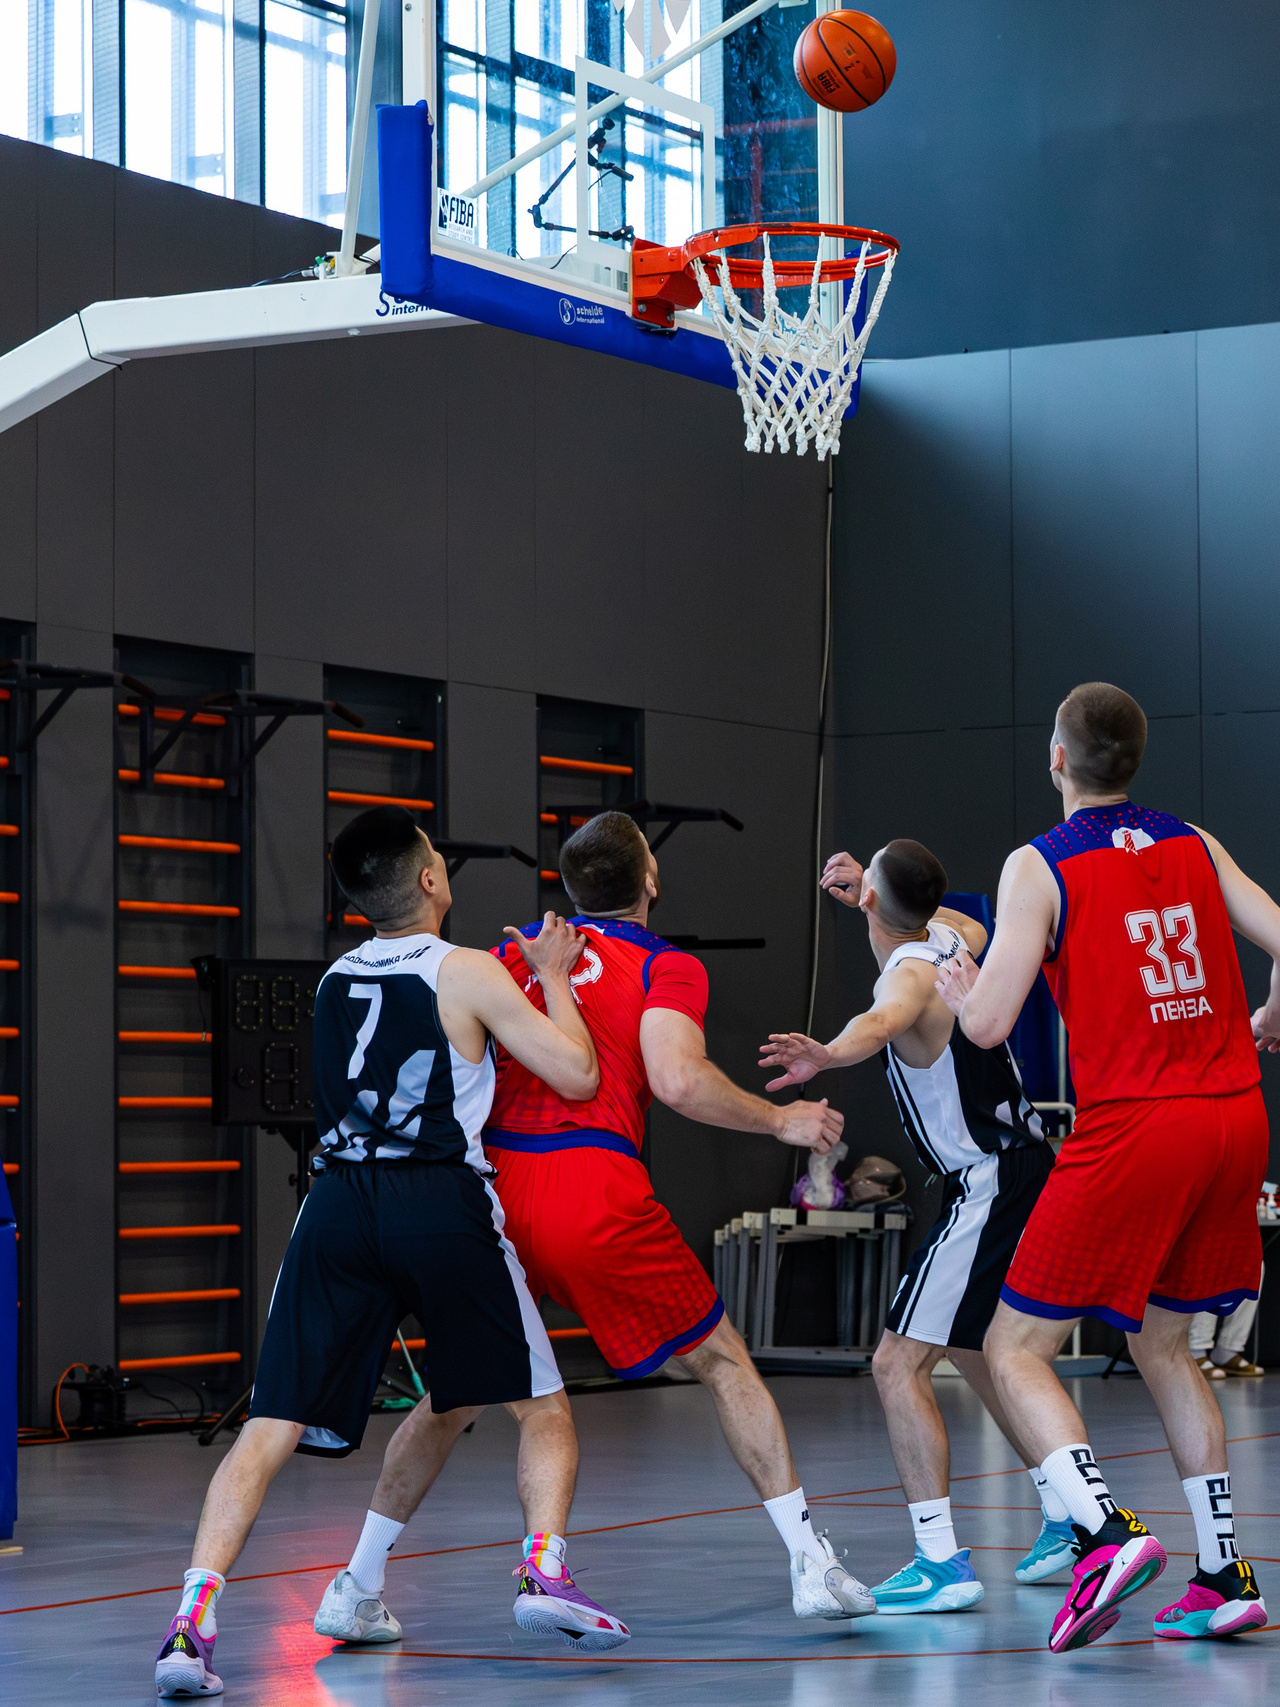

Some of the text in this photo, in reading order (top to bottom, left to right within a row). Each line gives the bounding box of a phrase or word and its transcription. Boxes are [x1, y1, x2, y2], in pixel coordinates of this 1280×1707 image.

[817, 69, 837, 94] FIBA
[449, 196, 474, 229] FIBA
[391, 303, 433, 316] intern
[1124, 902, 1206, 998] 33
[1150, 996, 1213, 1024] ПЕНЗА
[347, 983, 383, 1080] 7
